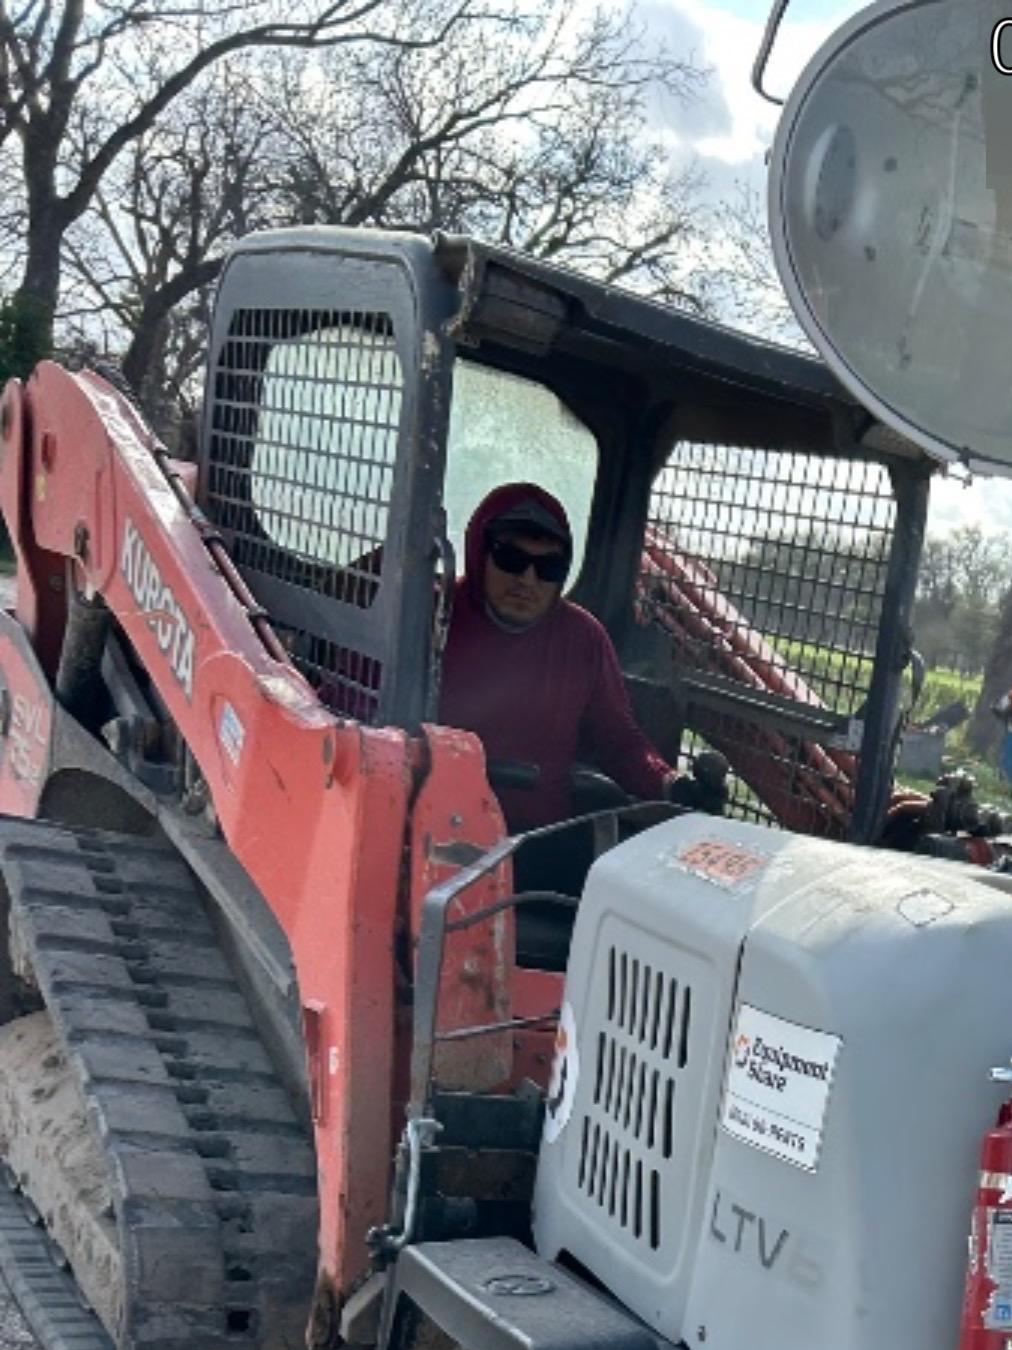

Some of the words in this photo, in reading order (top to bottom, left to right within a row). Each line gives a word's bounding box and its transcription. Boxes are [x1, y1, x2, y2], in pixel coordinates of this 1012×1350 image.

[121, 517, 195, 701] KUBOTA
[747, 1060, 787, 1093] Share
[752, 1036, 829, 1081] Equipment
